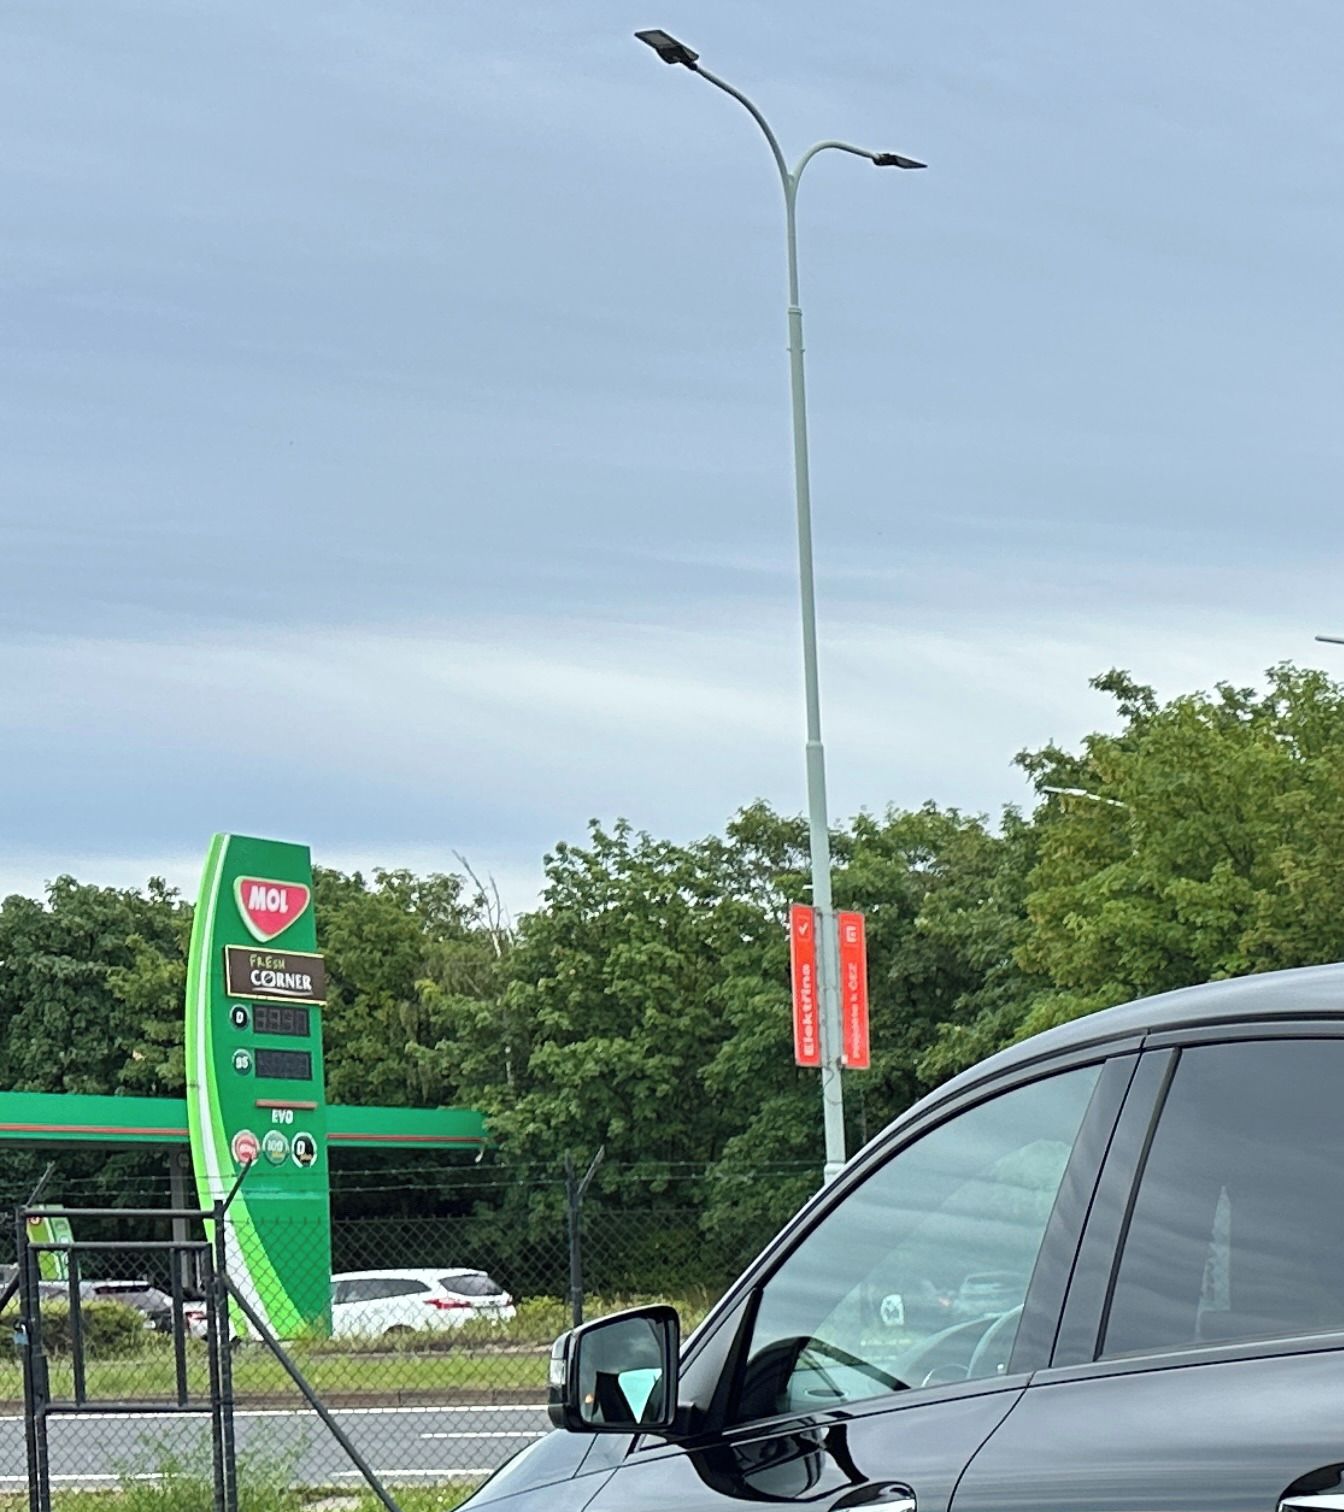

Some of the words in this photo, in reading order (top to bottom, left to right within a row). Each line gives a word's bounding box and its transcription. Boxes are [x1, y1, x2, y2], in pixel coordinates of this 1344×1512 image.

[248, 885, 288, 913] MOL
[249, 953, 286, 970] FRESH
[250, 969, 312, 991] CORNER
[235, 1011, 245, 1024] D
[271, 1109, 294, 1125] EVO
